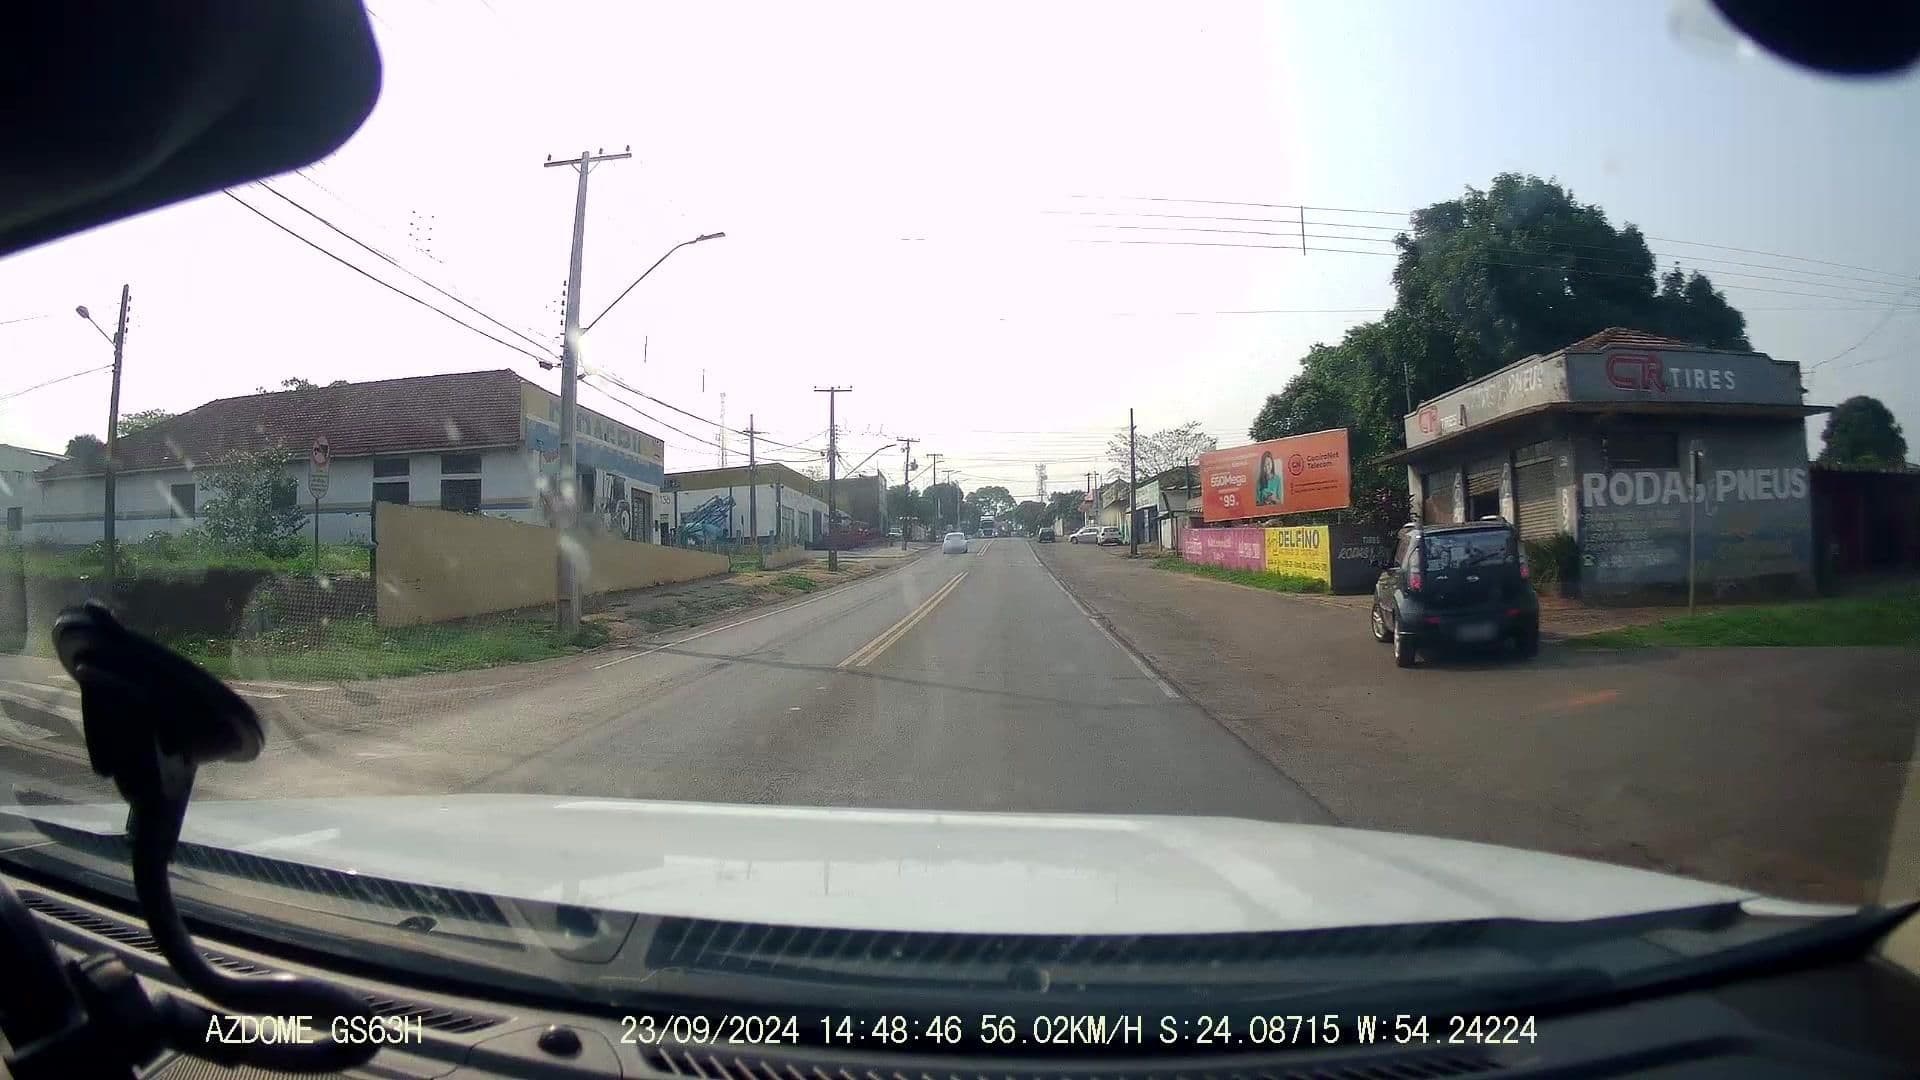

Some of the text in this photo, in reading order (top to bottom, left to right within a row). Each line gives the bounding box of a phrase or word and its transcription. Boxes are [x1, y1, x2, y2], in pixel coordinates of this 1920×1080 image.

[1606, 352, 1736, 392] CR TIRES
[1715, 467, 1808, 503] PNEUS
